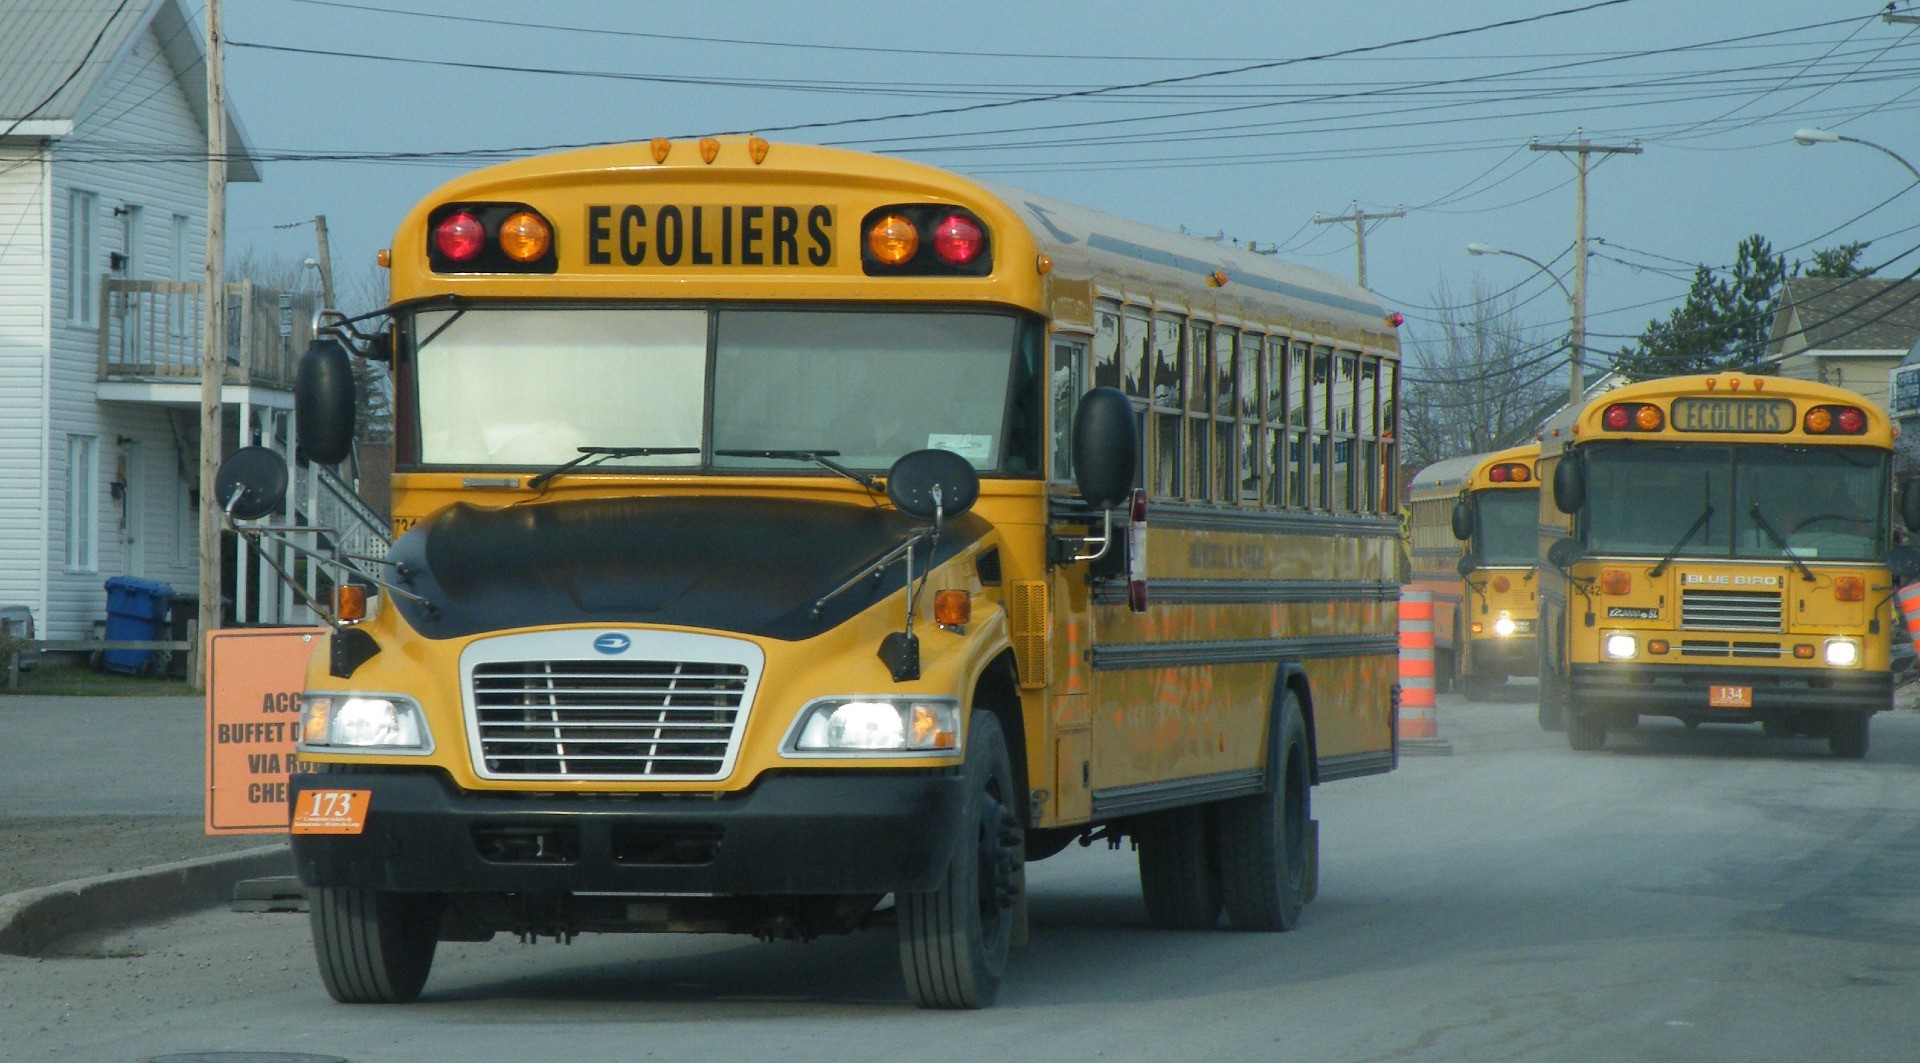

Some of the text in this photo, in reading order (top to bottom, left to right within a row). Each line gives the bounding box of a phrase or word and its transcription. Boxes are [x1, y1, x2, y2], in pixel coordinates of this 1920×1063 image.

[588, 204, 832, 266] ECOLIERS
[1686, 402, 1780, 432] ECOLIERS
[1688, 574, 1776, 586] BLUE BIRD
[1720, 687, 1743, 699] 134
[218, 722, 285, 744] BUFFET
[248, 753, 281, 774] VIA
[248, 782, 290, 803] CHE
[310, 792, 352, 817] 173
